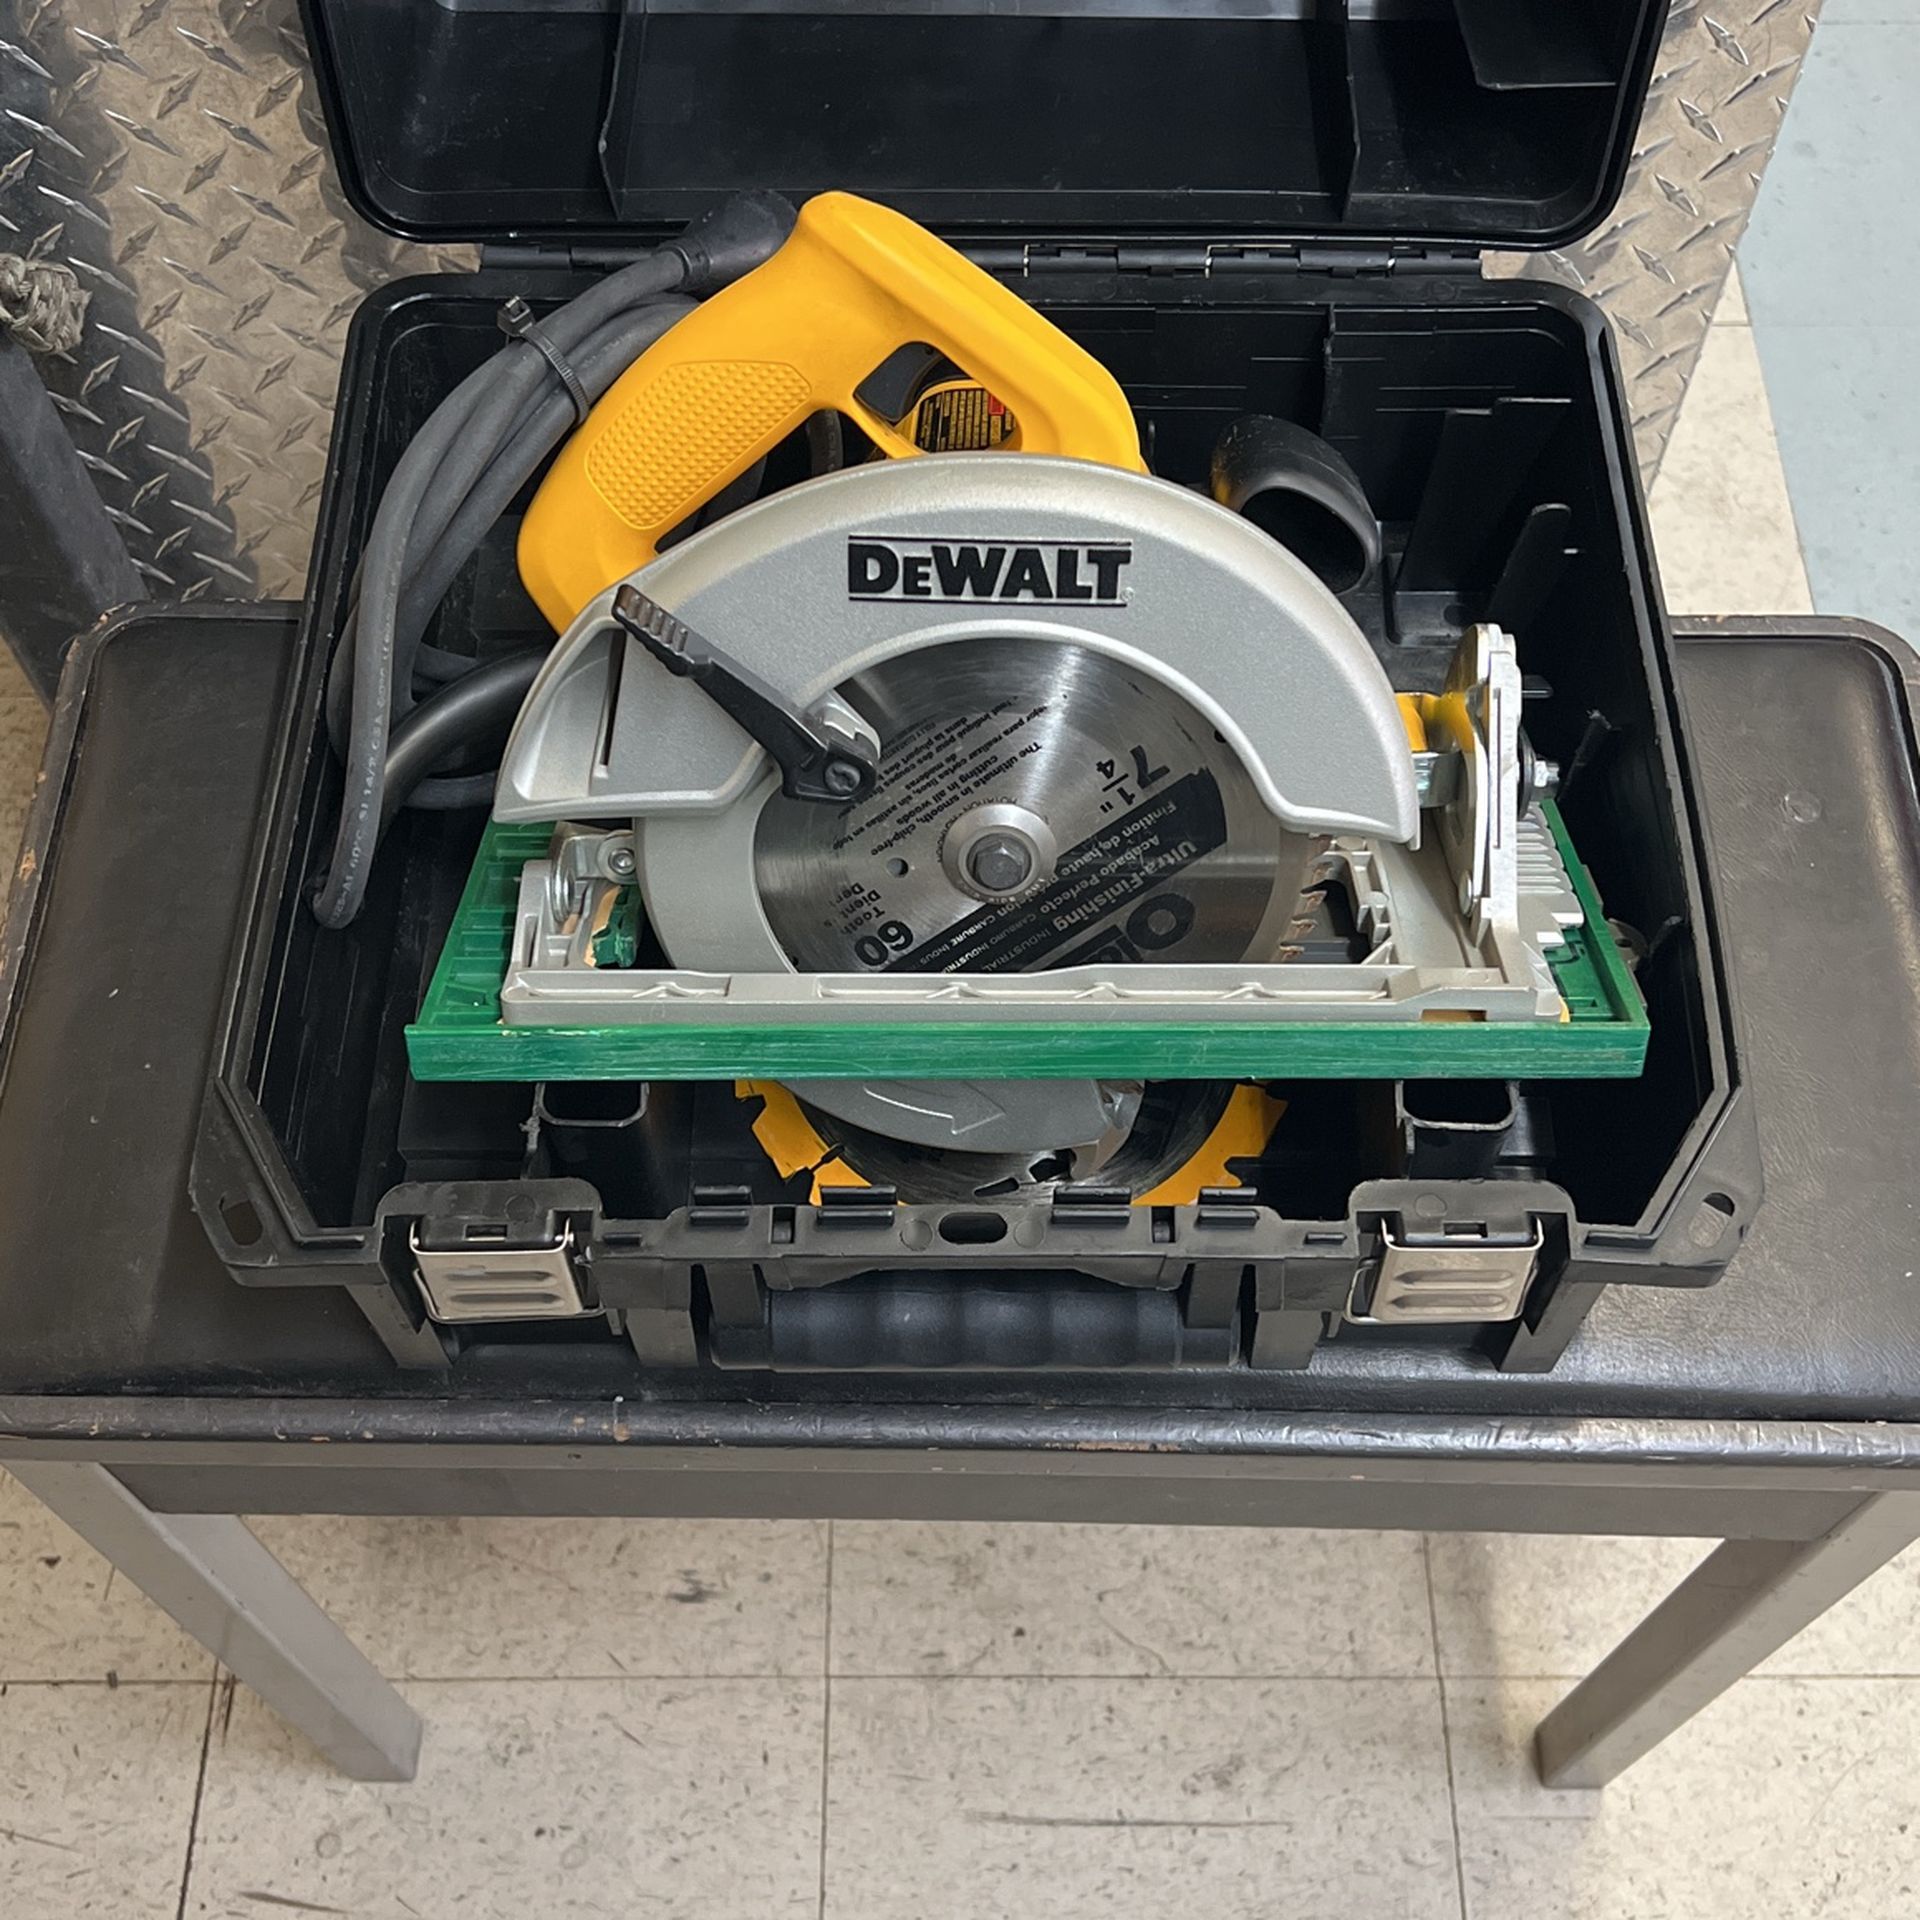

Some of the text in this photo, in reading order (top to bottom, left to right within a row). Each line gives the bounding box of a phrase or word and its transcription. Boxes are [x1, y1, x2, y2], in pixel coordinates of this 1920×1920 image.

[848, 541, 1132, 600] DEWALT
[944, 716, 967, 734] dans
[1002, 718, 1024, 736] para
[1026, 706, 1047, 722] ejor
[933, 732, 945, 740] la
[935, 734, 956, 752] pour
[968, 734, 1002, 760] realizar
[900, 737, 934, 764] plupart
[916, 751, 933, 764] des
[882, 763, 916, 787] coupes
[883, 761, 900, 775] des
[904, 753, 956, 790] de maderas
[870, 742, 1041, 855] The ultimate in smooth, chip-free
[895, 755, 998, 825] cutting in all woods
[897, 794, 912, 806] sin
[852, 826, 864, 836] en
[1121, 801, 1176, 837] Finition
[1099, 835, 1120, 849] de
[1099, 834, 1159, 875] Acabado
[1061, 847, 1102, 875] haute
[1039, 873, 1100, 913] Perfecto
[1052, 841, 1196, 931] Ultra-Finishing
[950, 915, 995, 945] CARBURE
[854, 920, 913, 967] 60
